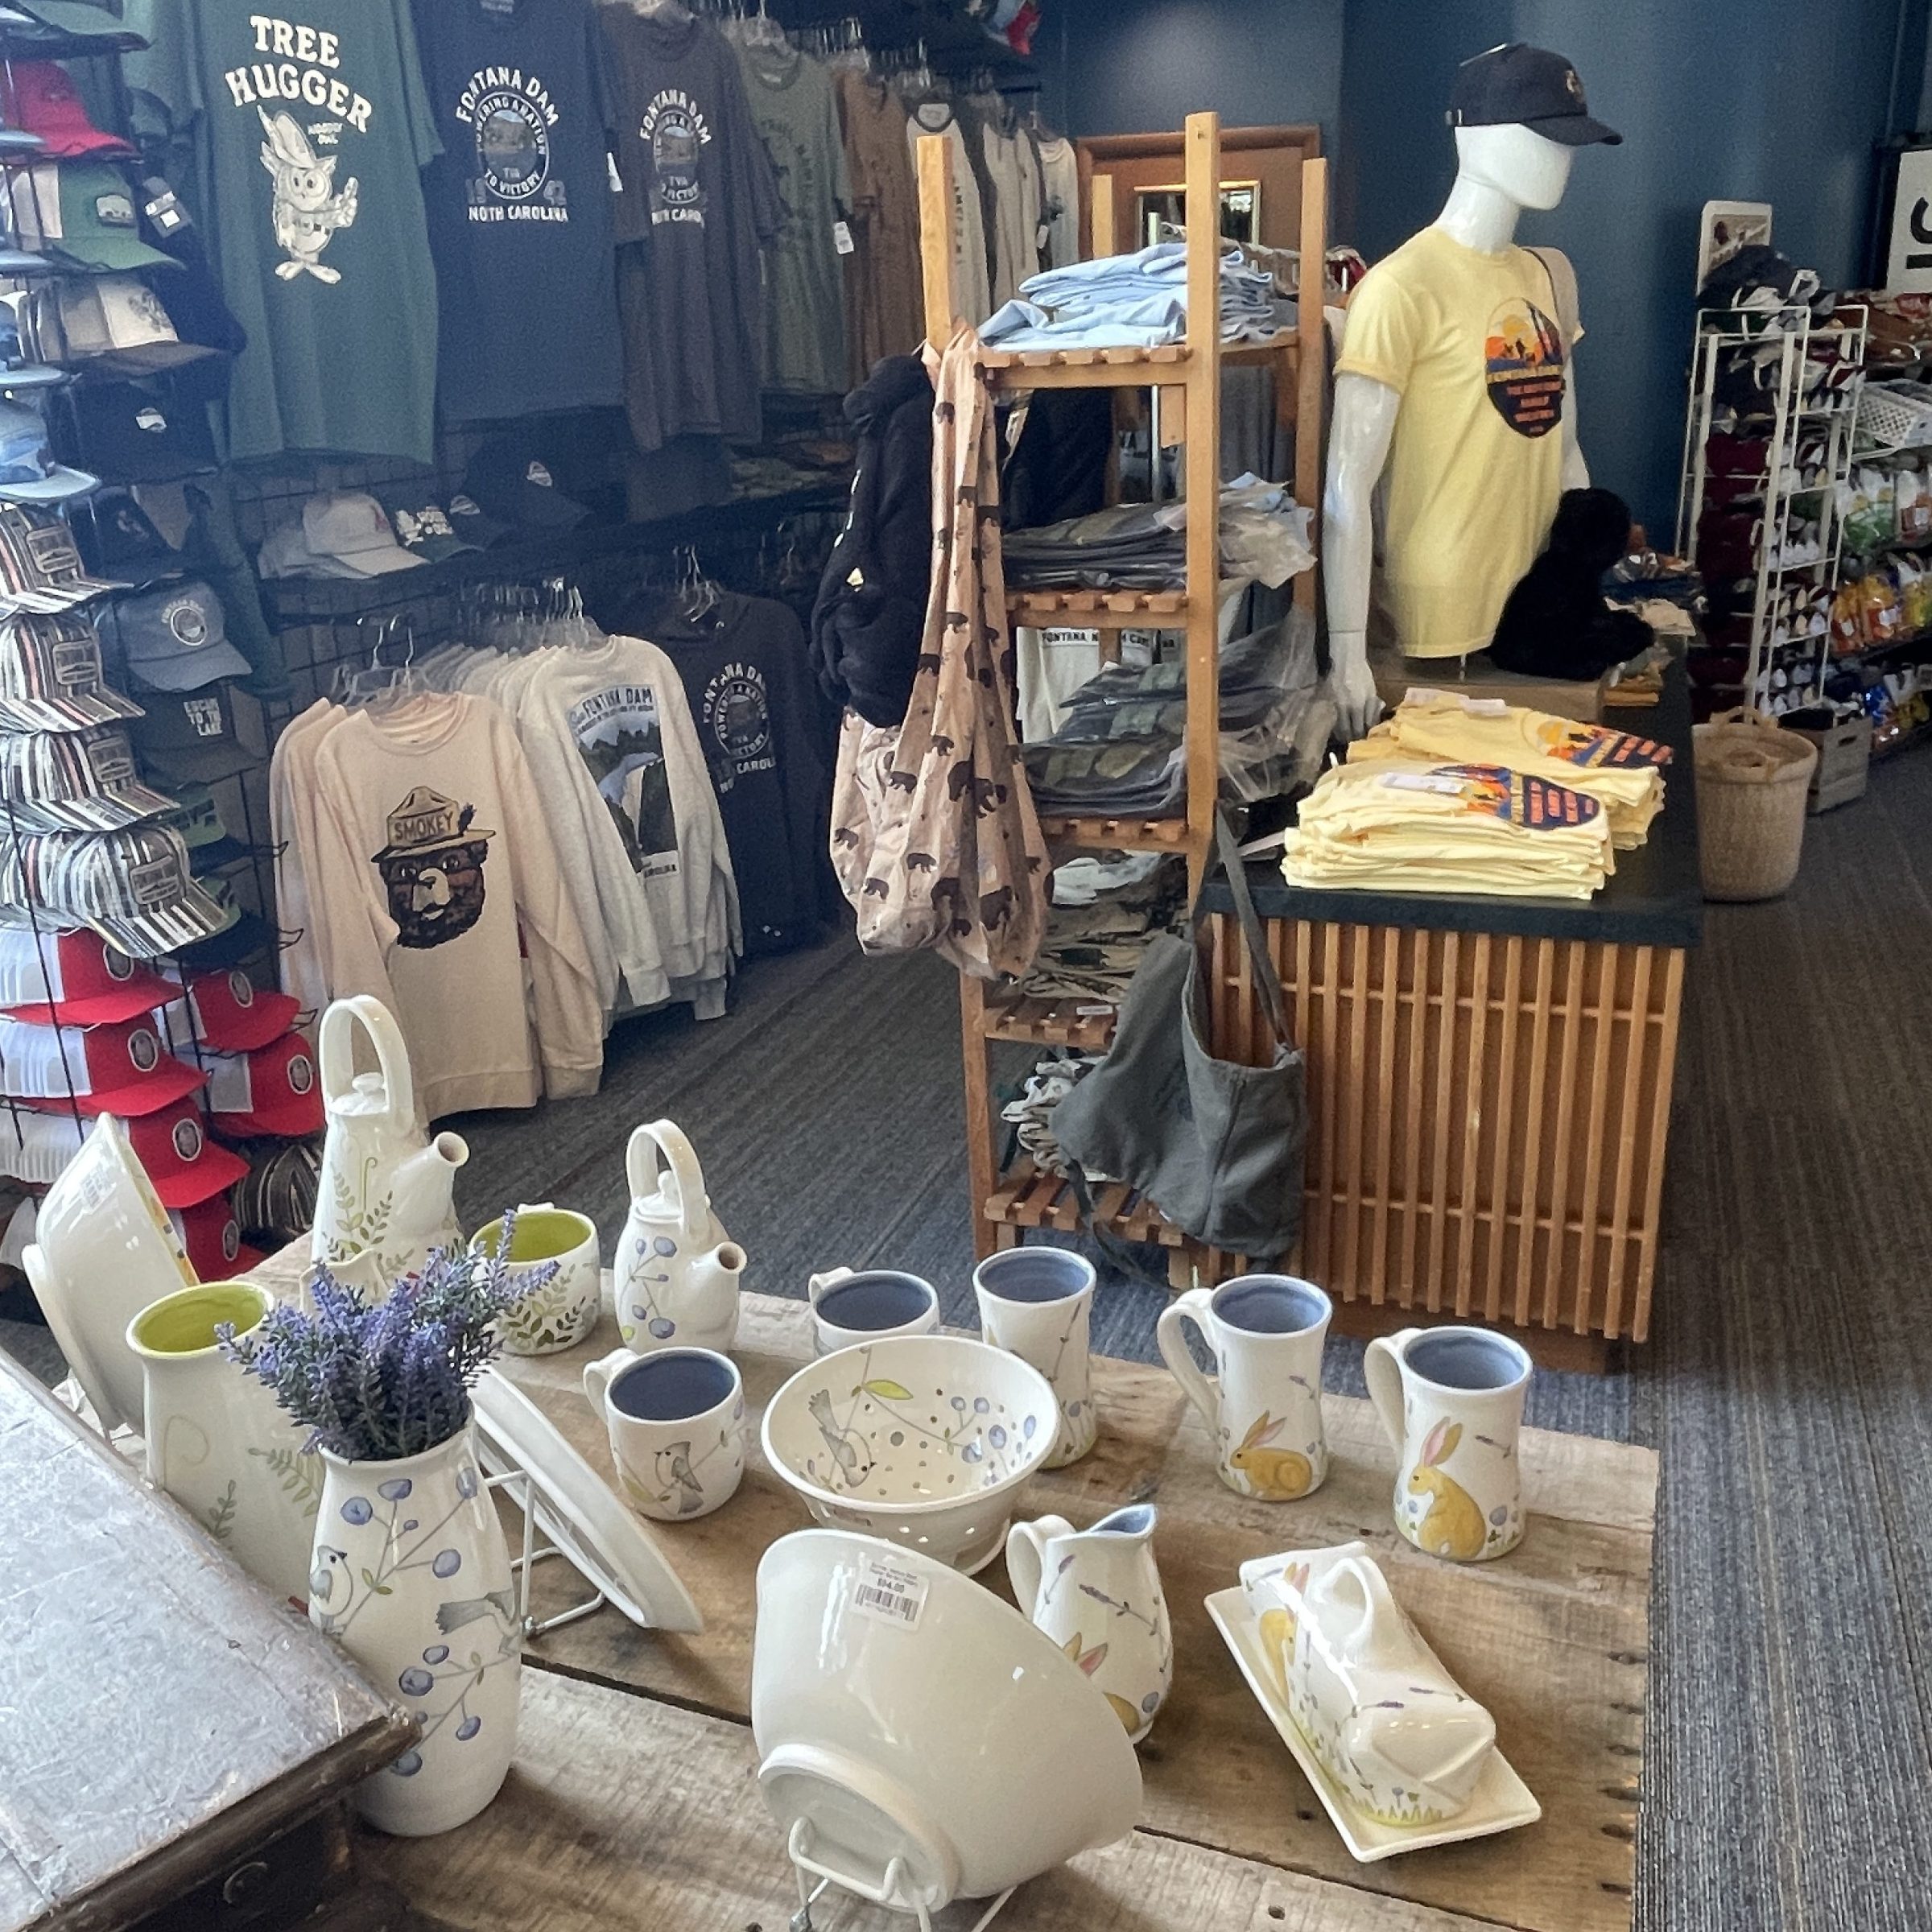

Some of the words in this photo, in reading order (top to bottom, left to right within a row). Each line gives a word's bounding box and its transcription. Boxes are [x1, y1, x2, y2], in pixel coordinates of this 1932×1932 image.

[250, 15, 340, 69] TREE
[225, 64, 372, 133] HUGGER
[456, 66, 522, 123] FONTANA
[525, 76, 559, 126] DAM
[640, 89, 687, 140] FONTANA
[688, 100, 712, 145] DAM
[469, 205, 504, 222] NOTH
[582, 687, 621, 718] FONTANA
[625, 687, 653, 704] DAM
[394, 810, 454, 840] SMOKEY
